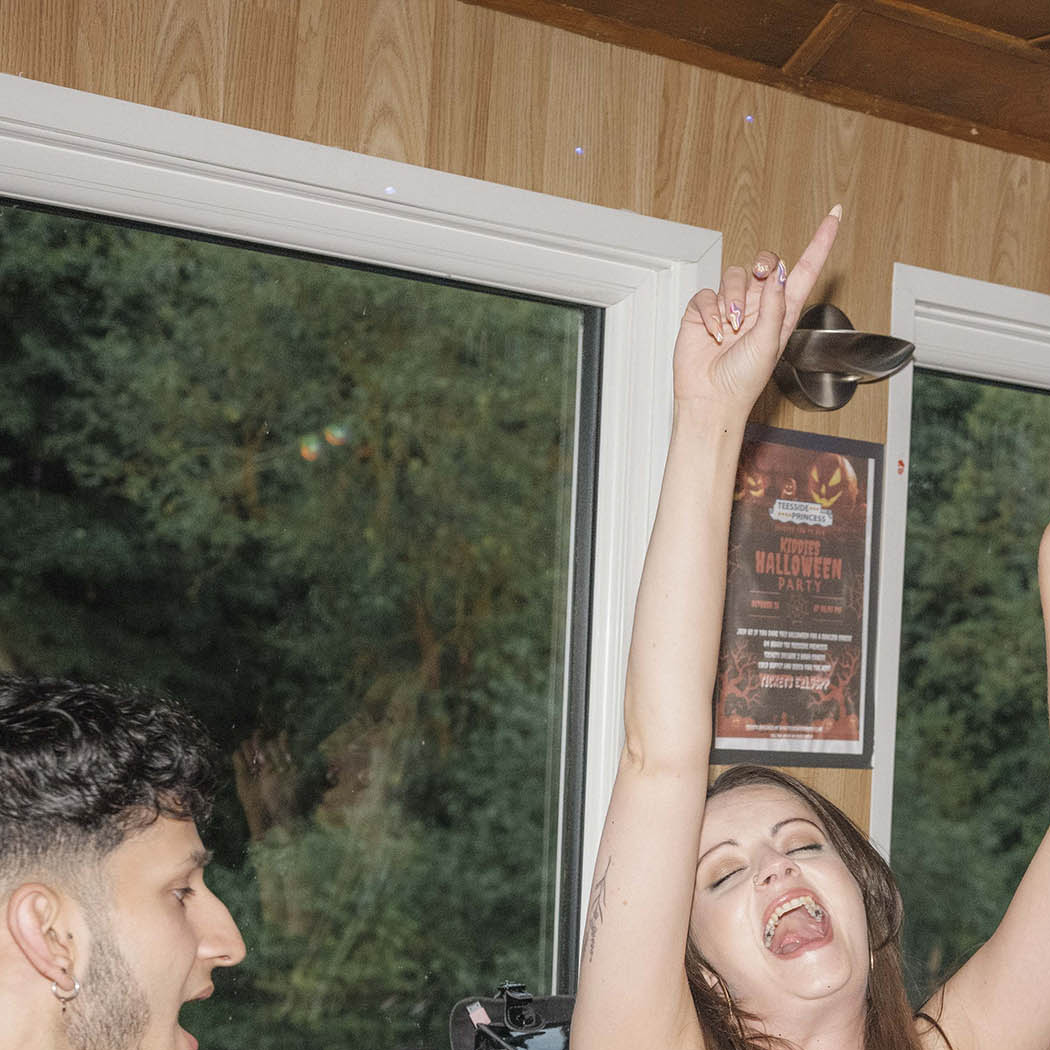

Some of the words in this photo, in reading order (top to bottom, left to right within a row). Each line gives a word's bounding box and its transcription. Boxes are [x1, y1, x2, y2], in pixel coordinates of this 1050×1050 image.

[778, 502, 809, 512] TEESSIDE
[791, 512, 826, 523] PRINCESS
[780, 537, 820, 556] KIDDIES
[755, 551, 842, 580] HALLOWEEN
[778, 577, 821, 593] PARTY
